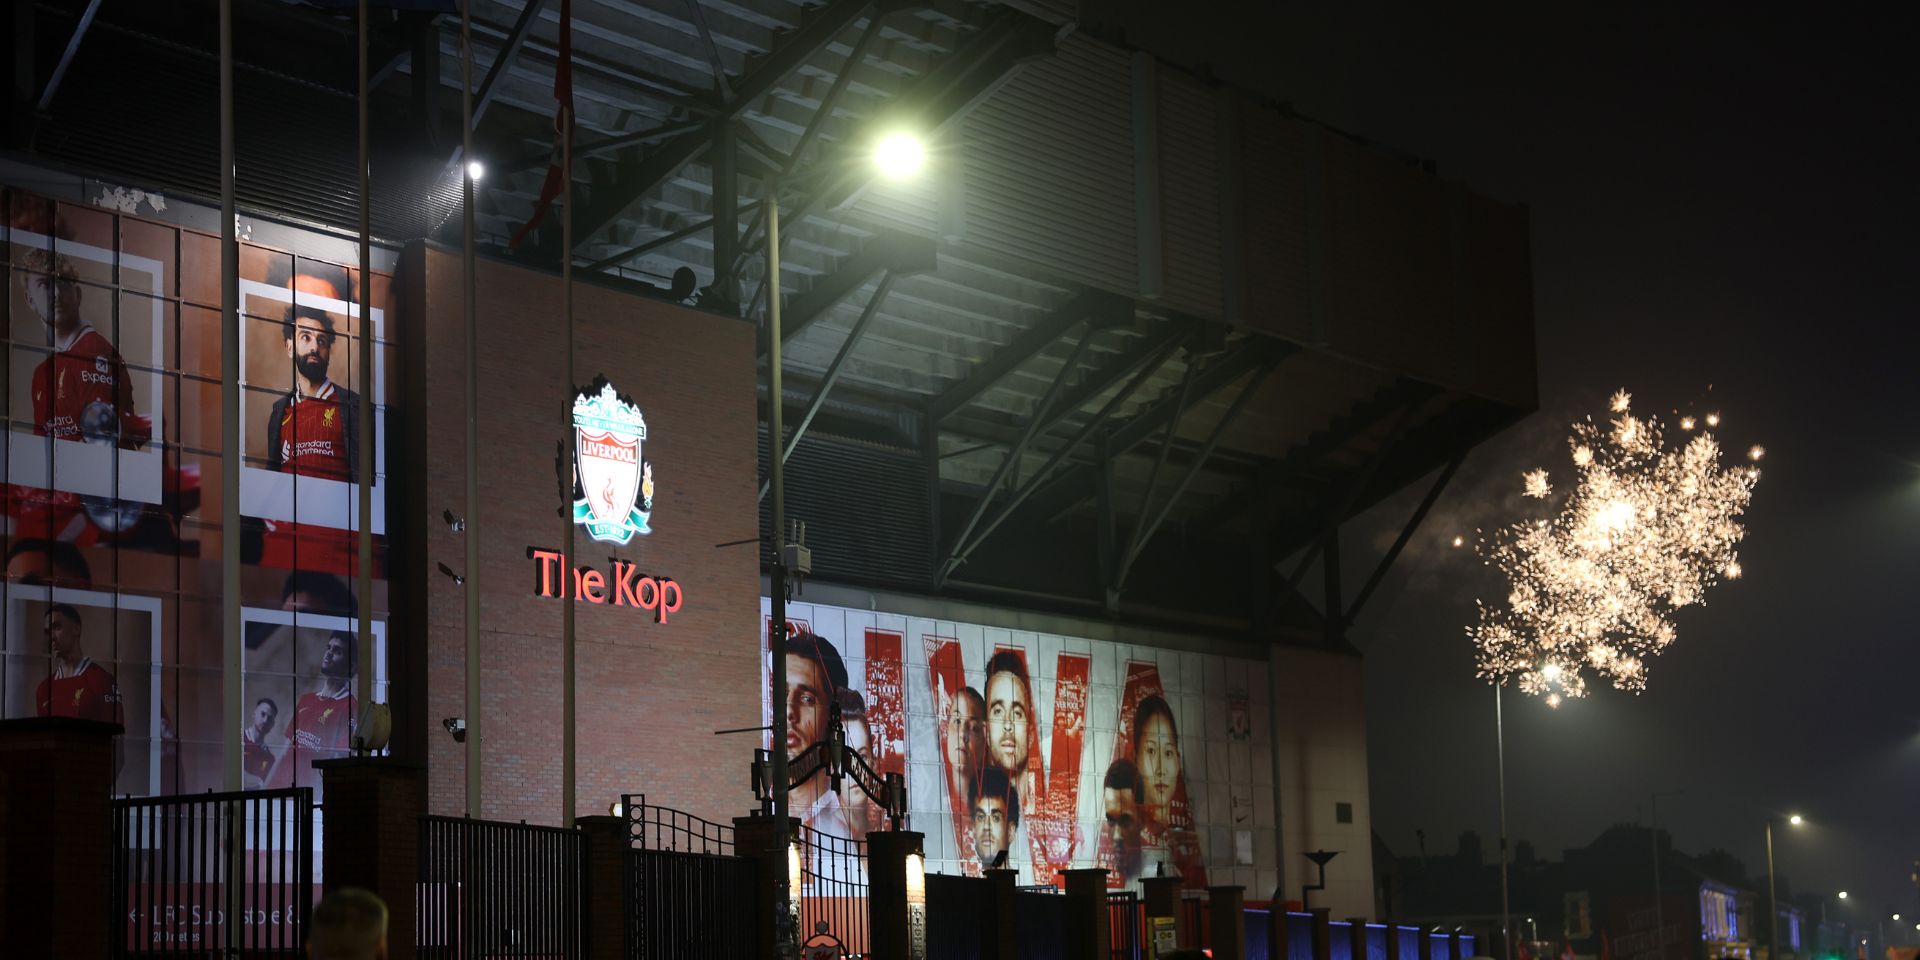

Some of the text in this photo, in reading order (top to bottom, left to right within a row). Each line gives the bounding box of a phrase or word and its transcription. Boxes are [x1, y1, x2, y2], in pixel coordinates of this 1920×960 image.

[583, 440, 636, 463] LIVERPOOL
[533, 549, 683, 624] The Kop
